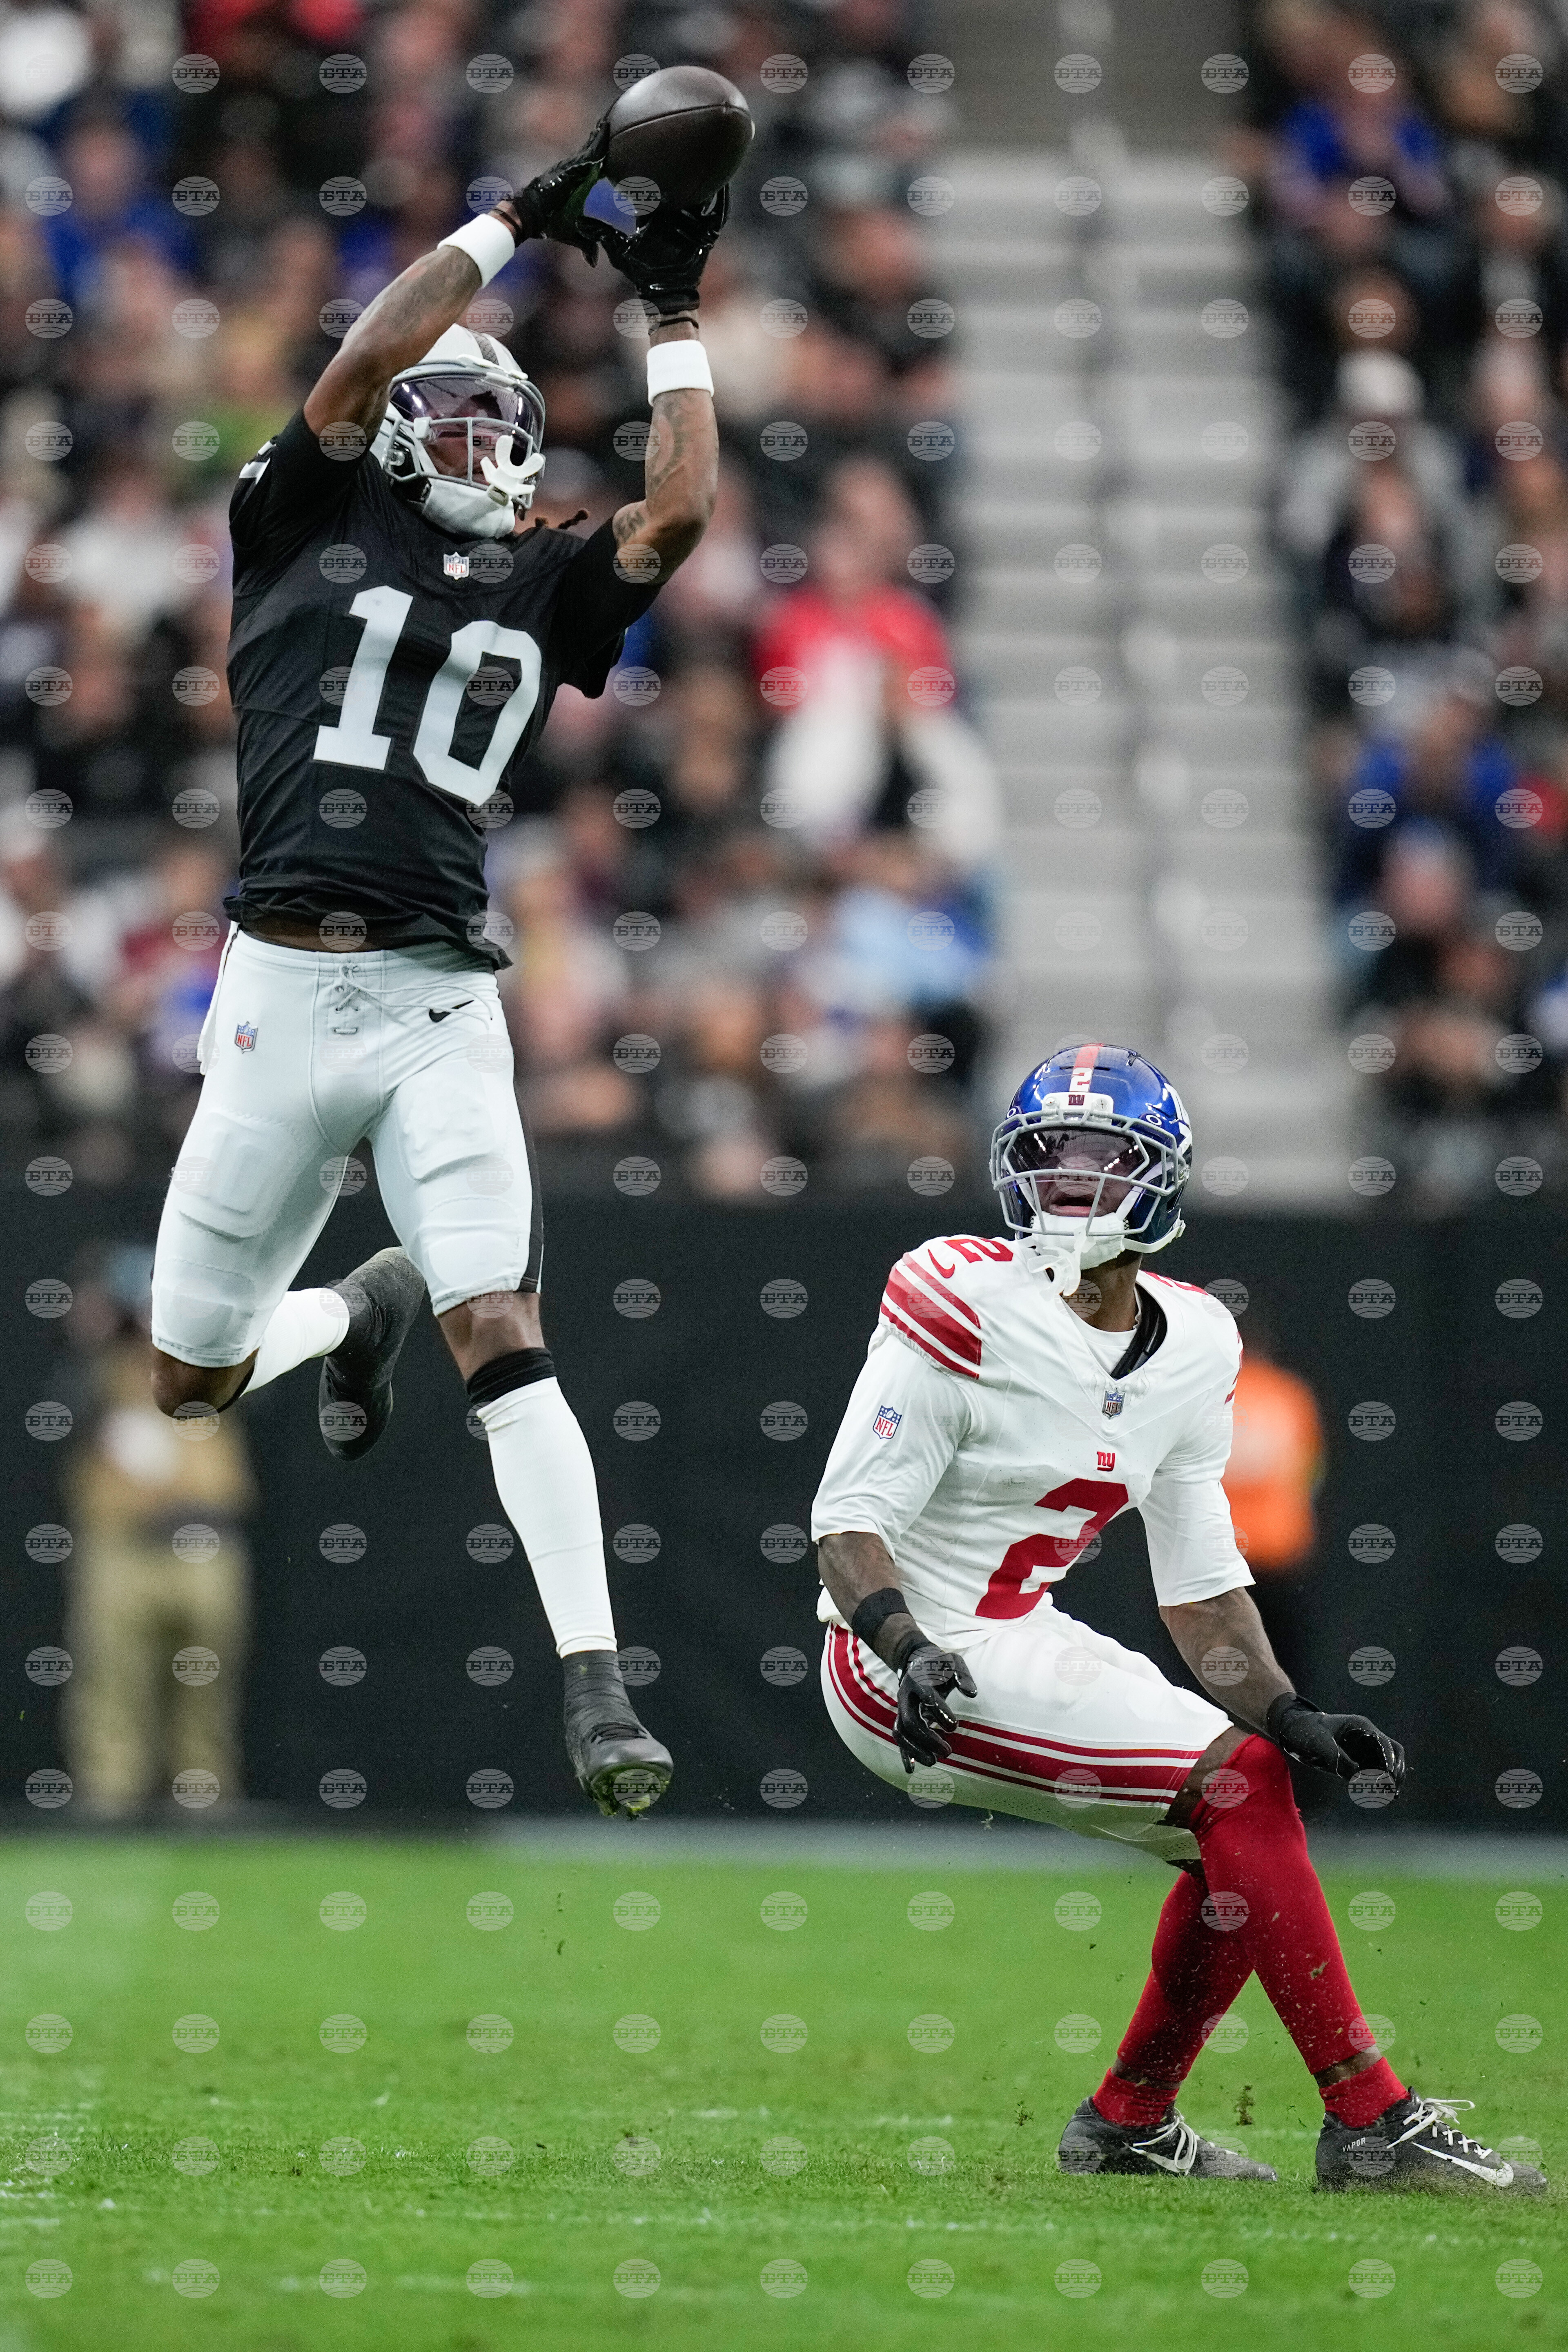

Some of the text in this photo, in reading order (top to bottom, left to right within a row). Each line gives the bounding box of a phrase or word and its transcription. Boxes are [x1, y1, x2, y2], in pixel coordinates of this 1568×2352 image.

[449, 564, 465, 573] NFL
[313, 586, 542, 806] 10
[237, 1034, 251, 1047] NFL
[1069, 1067, 1093, 1092] 2
[942, 1238, 1013, 1263] 2
[1105, 1401, 1120, 1413] NFL
[875, 1417, 893, 1436] NFL
[975, 1478, 1129, 1619] 2
[1342, 2137, 1366, 2152] VAPOR
